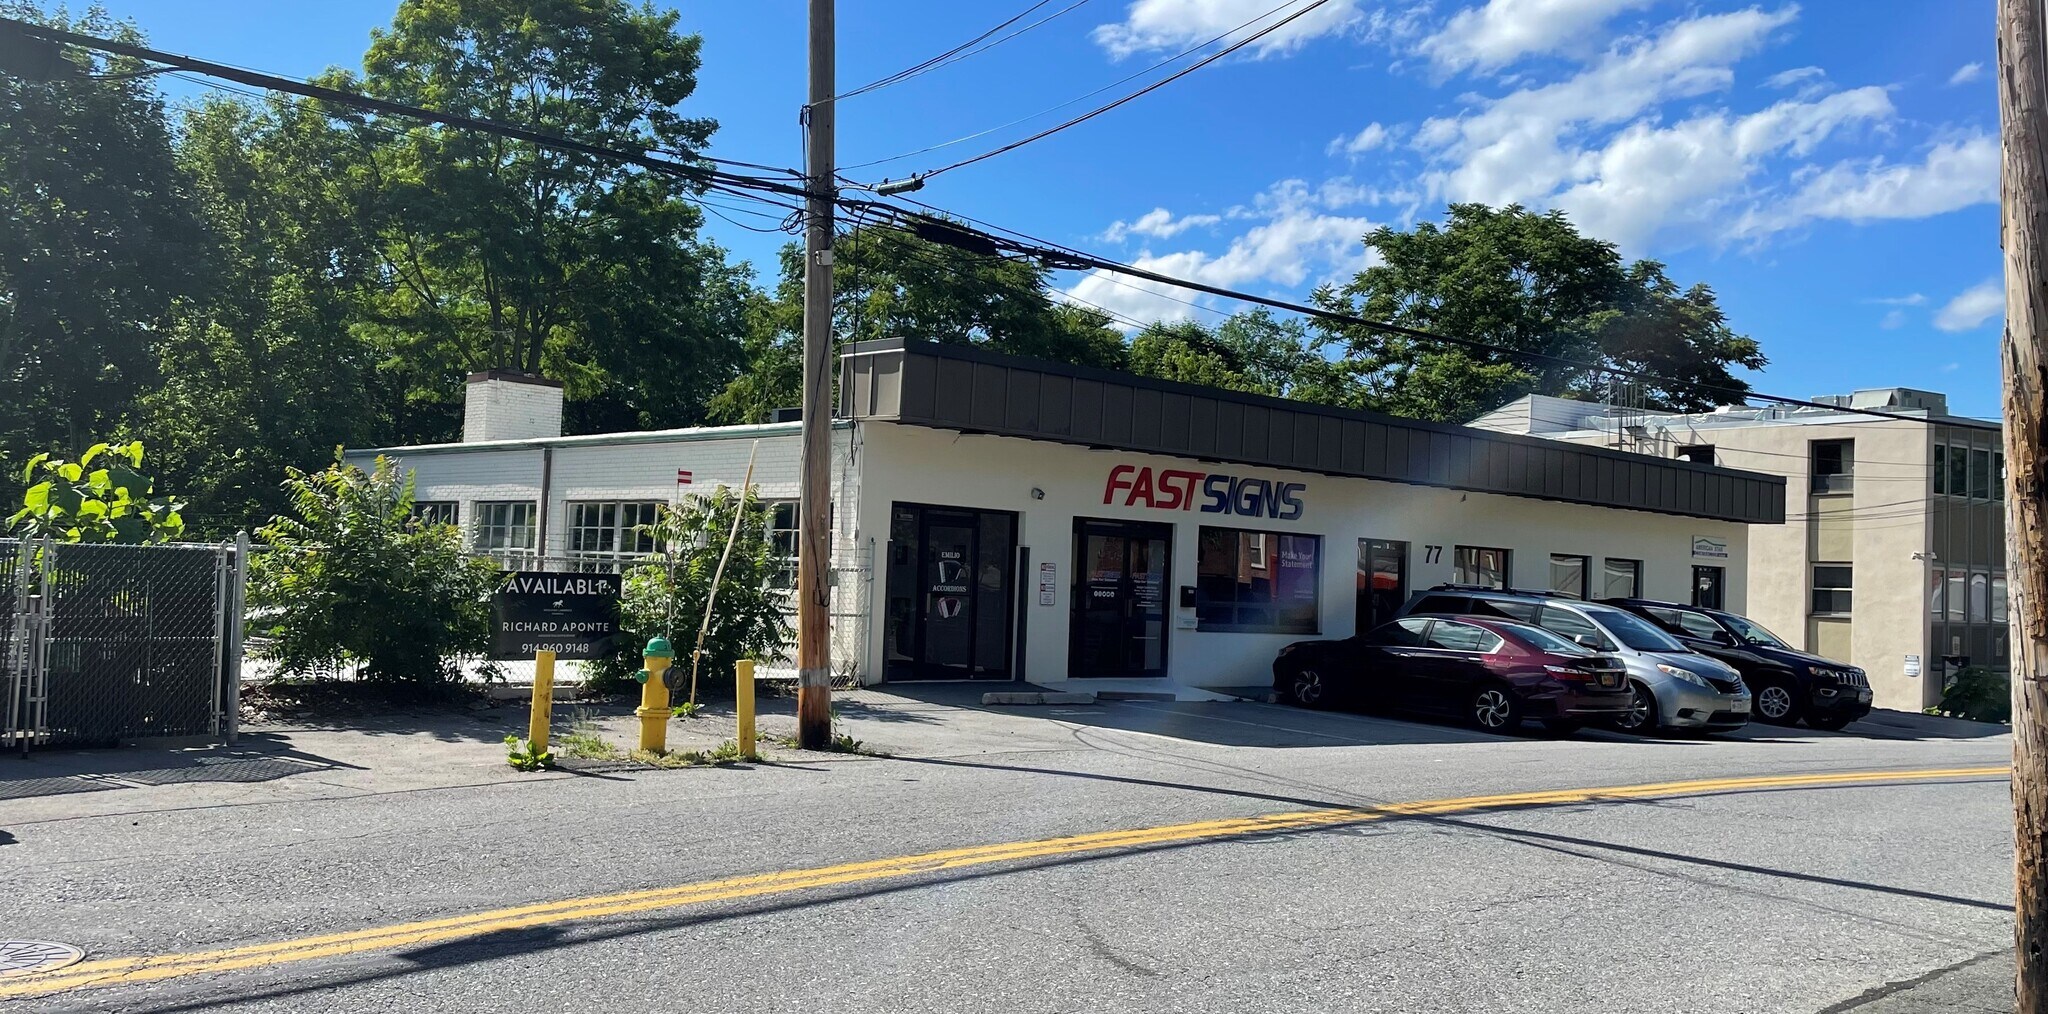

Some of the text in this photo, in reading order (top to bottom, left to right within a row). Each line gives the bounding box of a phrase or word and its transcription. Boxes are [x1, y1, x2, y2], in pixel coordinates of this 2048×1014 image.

[1103, 464, 1306, 521] FASTSIGNS
[941, 551, 961, 559] EMILIO
[1281, 551, 1312, 560] Make Your
[1425, 544, 1443, 565] 77
[1281, 560, 1312, 569] Statement
[506, 577, 608, 595] AVAILABLE
[932, 584, 967, 593] ACCORDIONS
[502, 621, 609, 632] RICHARD APONTE
[521, 643, 540, 653] 914
[565, 643, 589, 653] 9148
